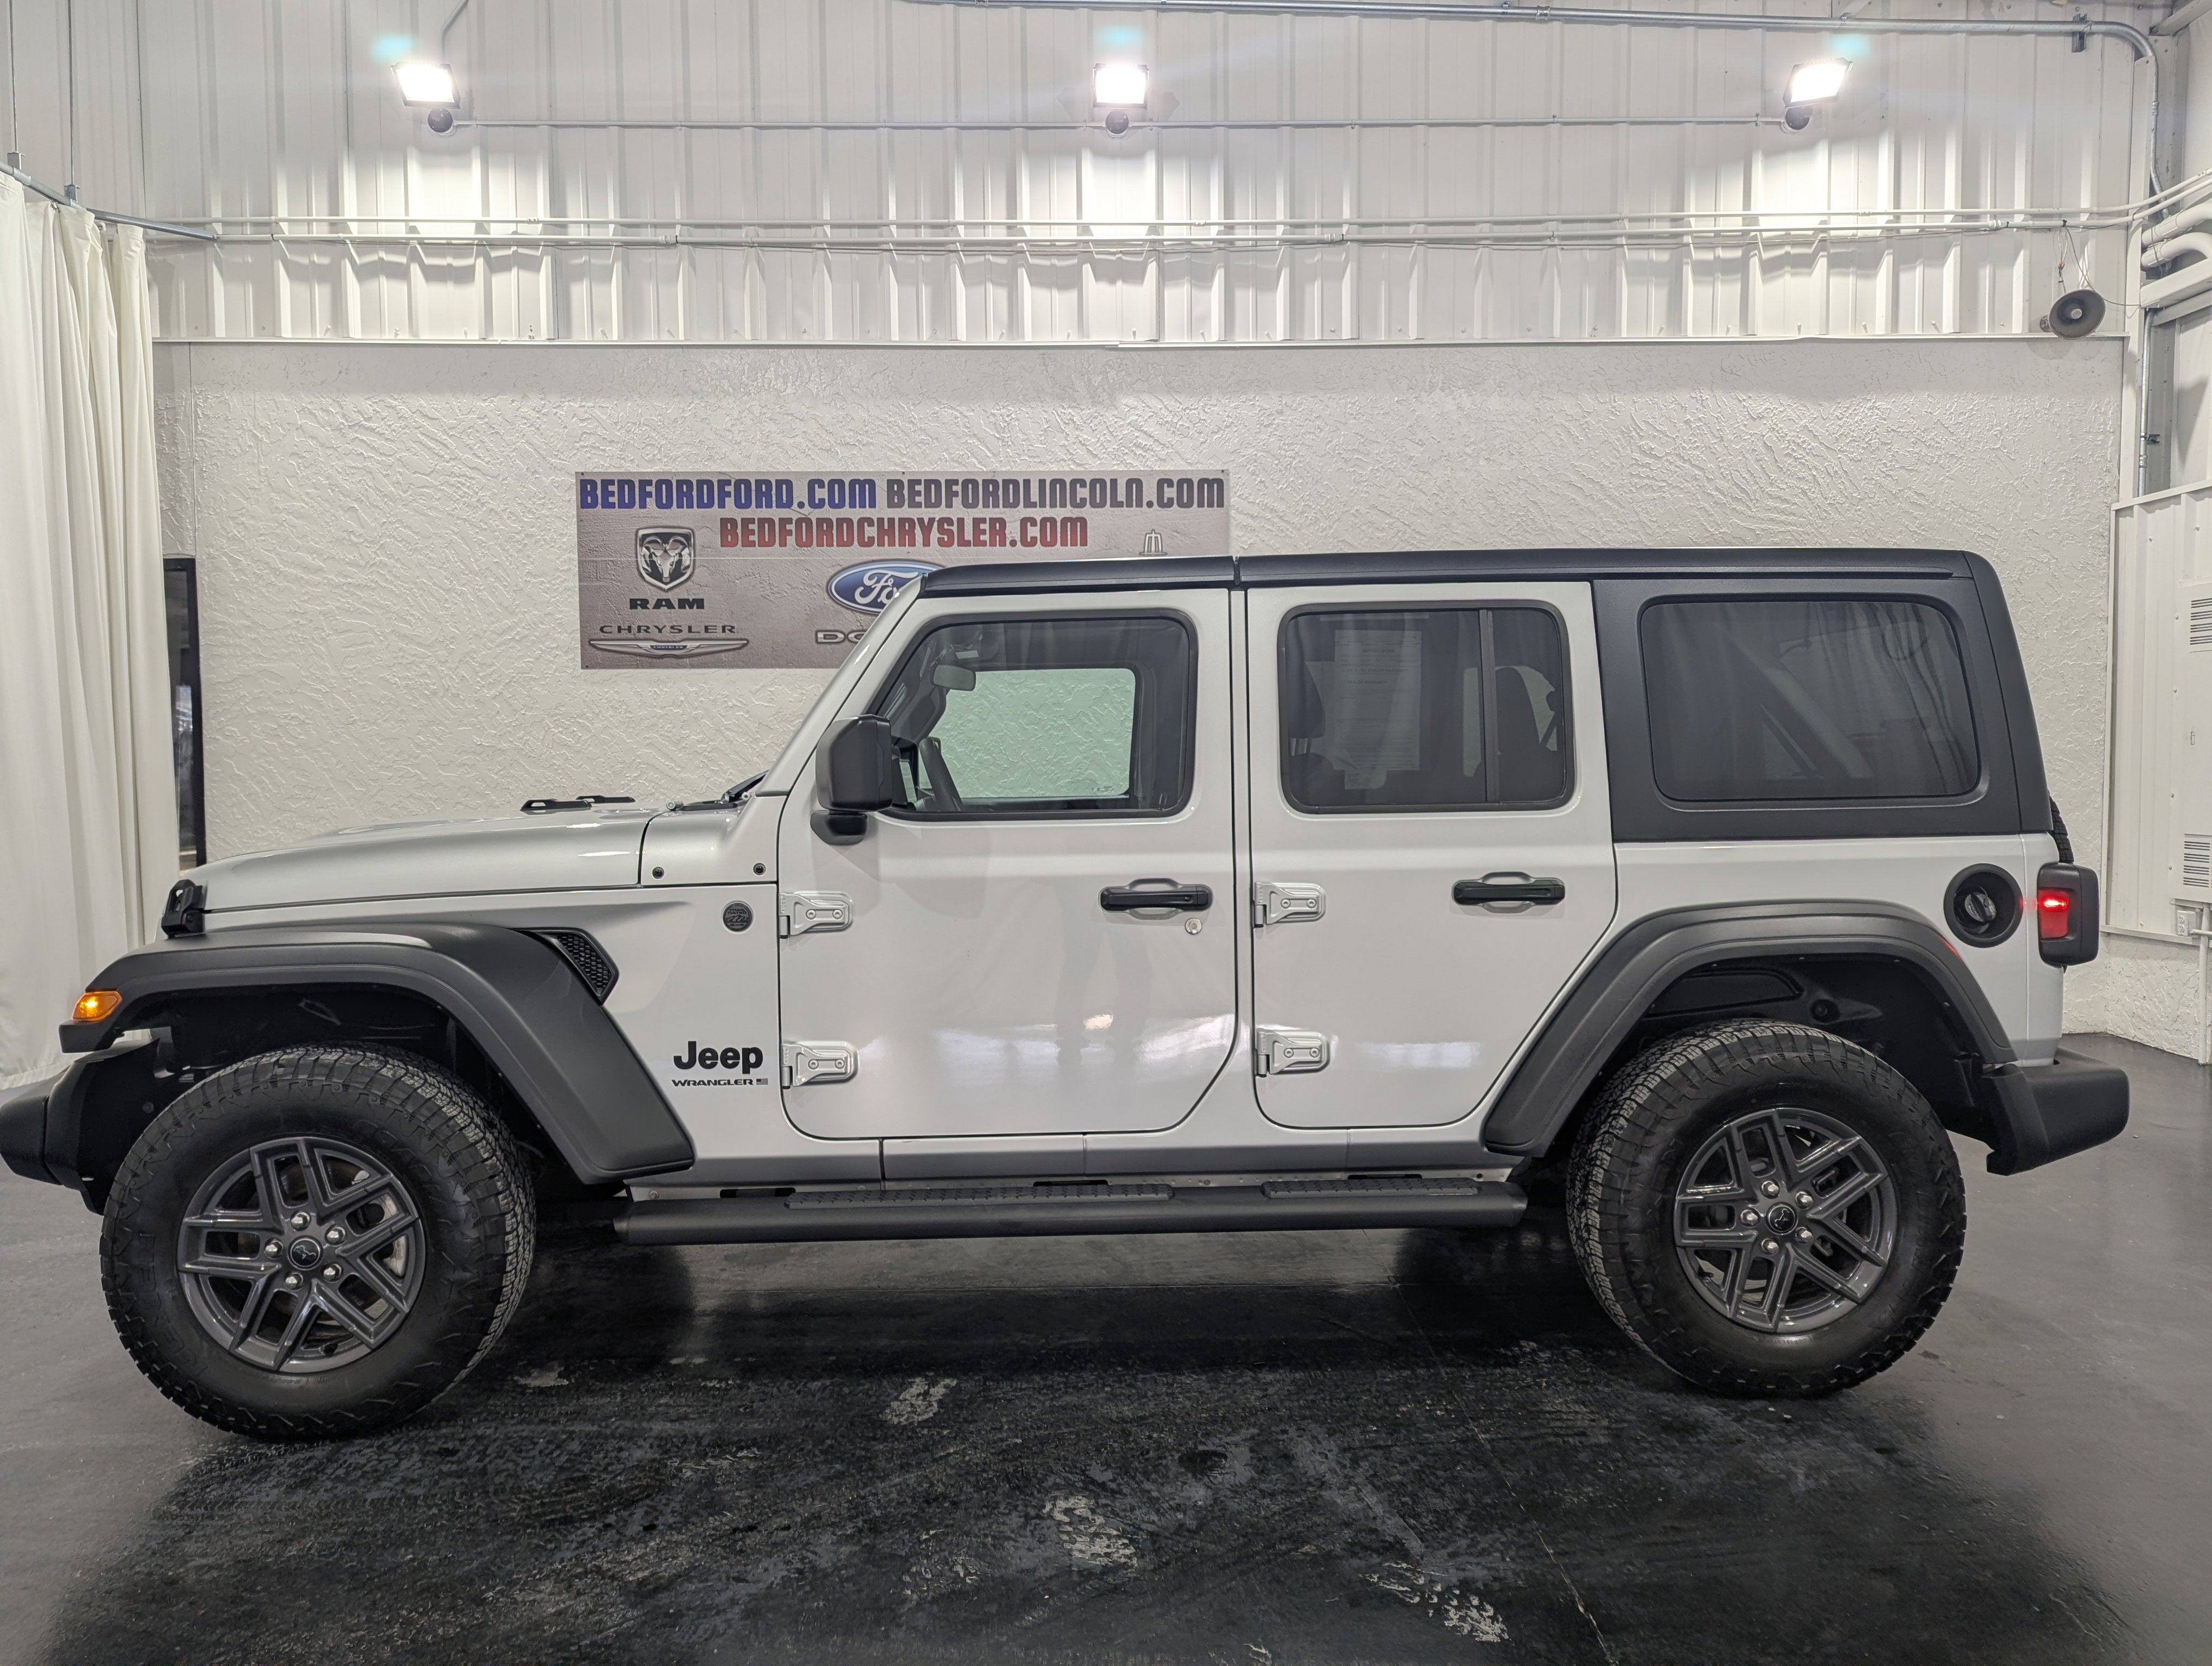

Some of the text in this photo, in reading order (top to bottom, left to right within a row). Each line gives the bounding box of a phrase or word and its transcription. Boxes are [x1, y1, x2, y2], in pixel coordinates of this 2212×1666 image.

[580, 478, 1224, 509] BEDFORDFORD.COM BEDFORDLINCOLN.COM
[719, 517, 1088, 547] BEDFORDCHRYSLER.COM
[854, 569, 918, 604] Fo
[629, 598, 704, 610] RAM
[600, 625, 736, 633] CHRYSLER
[673, 1041, 763, 1074] Jeep
[672, 1079, 754, 1087] WRANGLER
